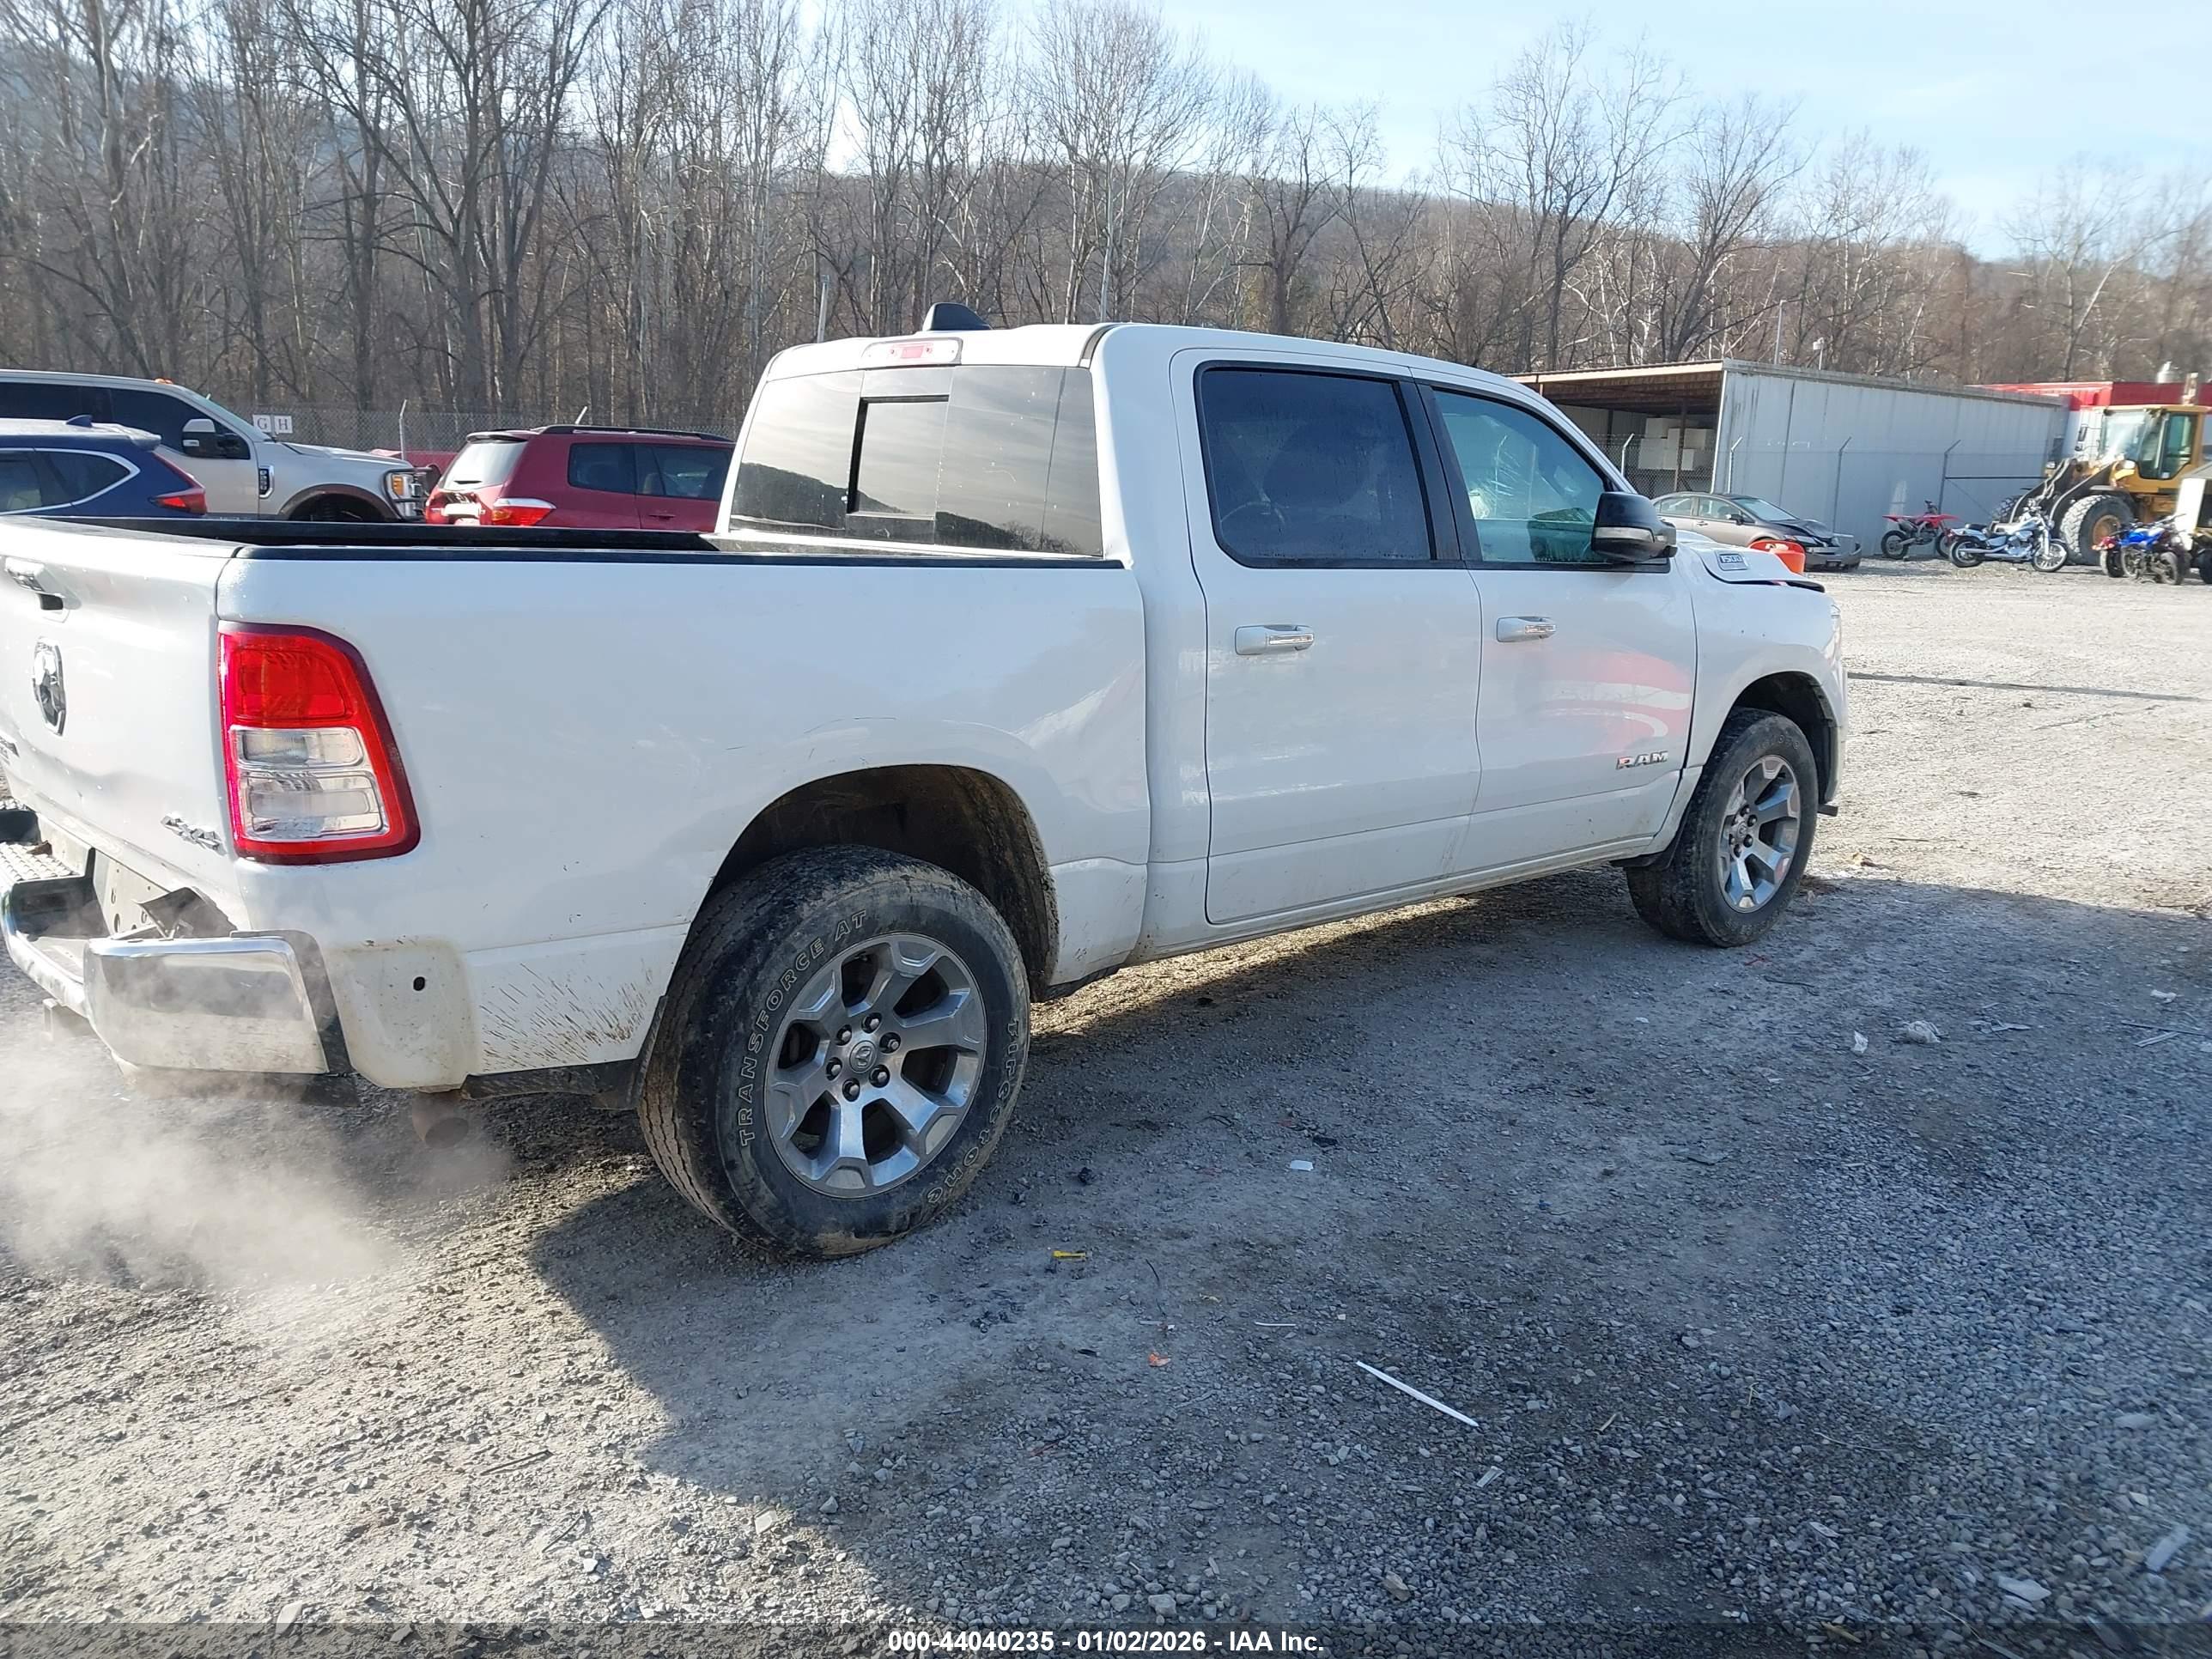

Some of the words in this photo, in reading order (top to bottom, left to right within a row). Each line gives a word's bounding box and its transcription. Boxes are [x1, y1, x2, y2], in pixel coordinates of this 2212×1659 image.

[257, 417, 268, 430] G
[277, 419, 289, 431] H
[1616, 750, 1668, 769] RAM
[738, 938, 825, 1146] TRANSFORCE
[835, 910, 866, 942] AT
